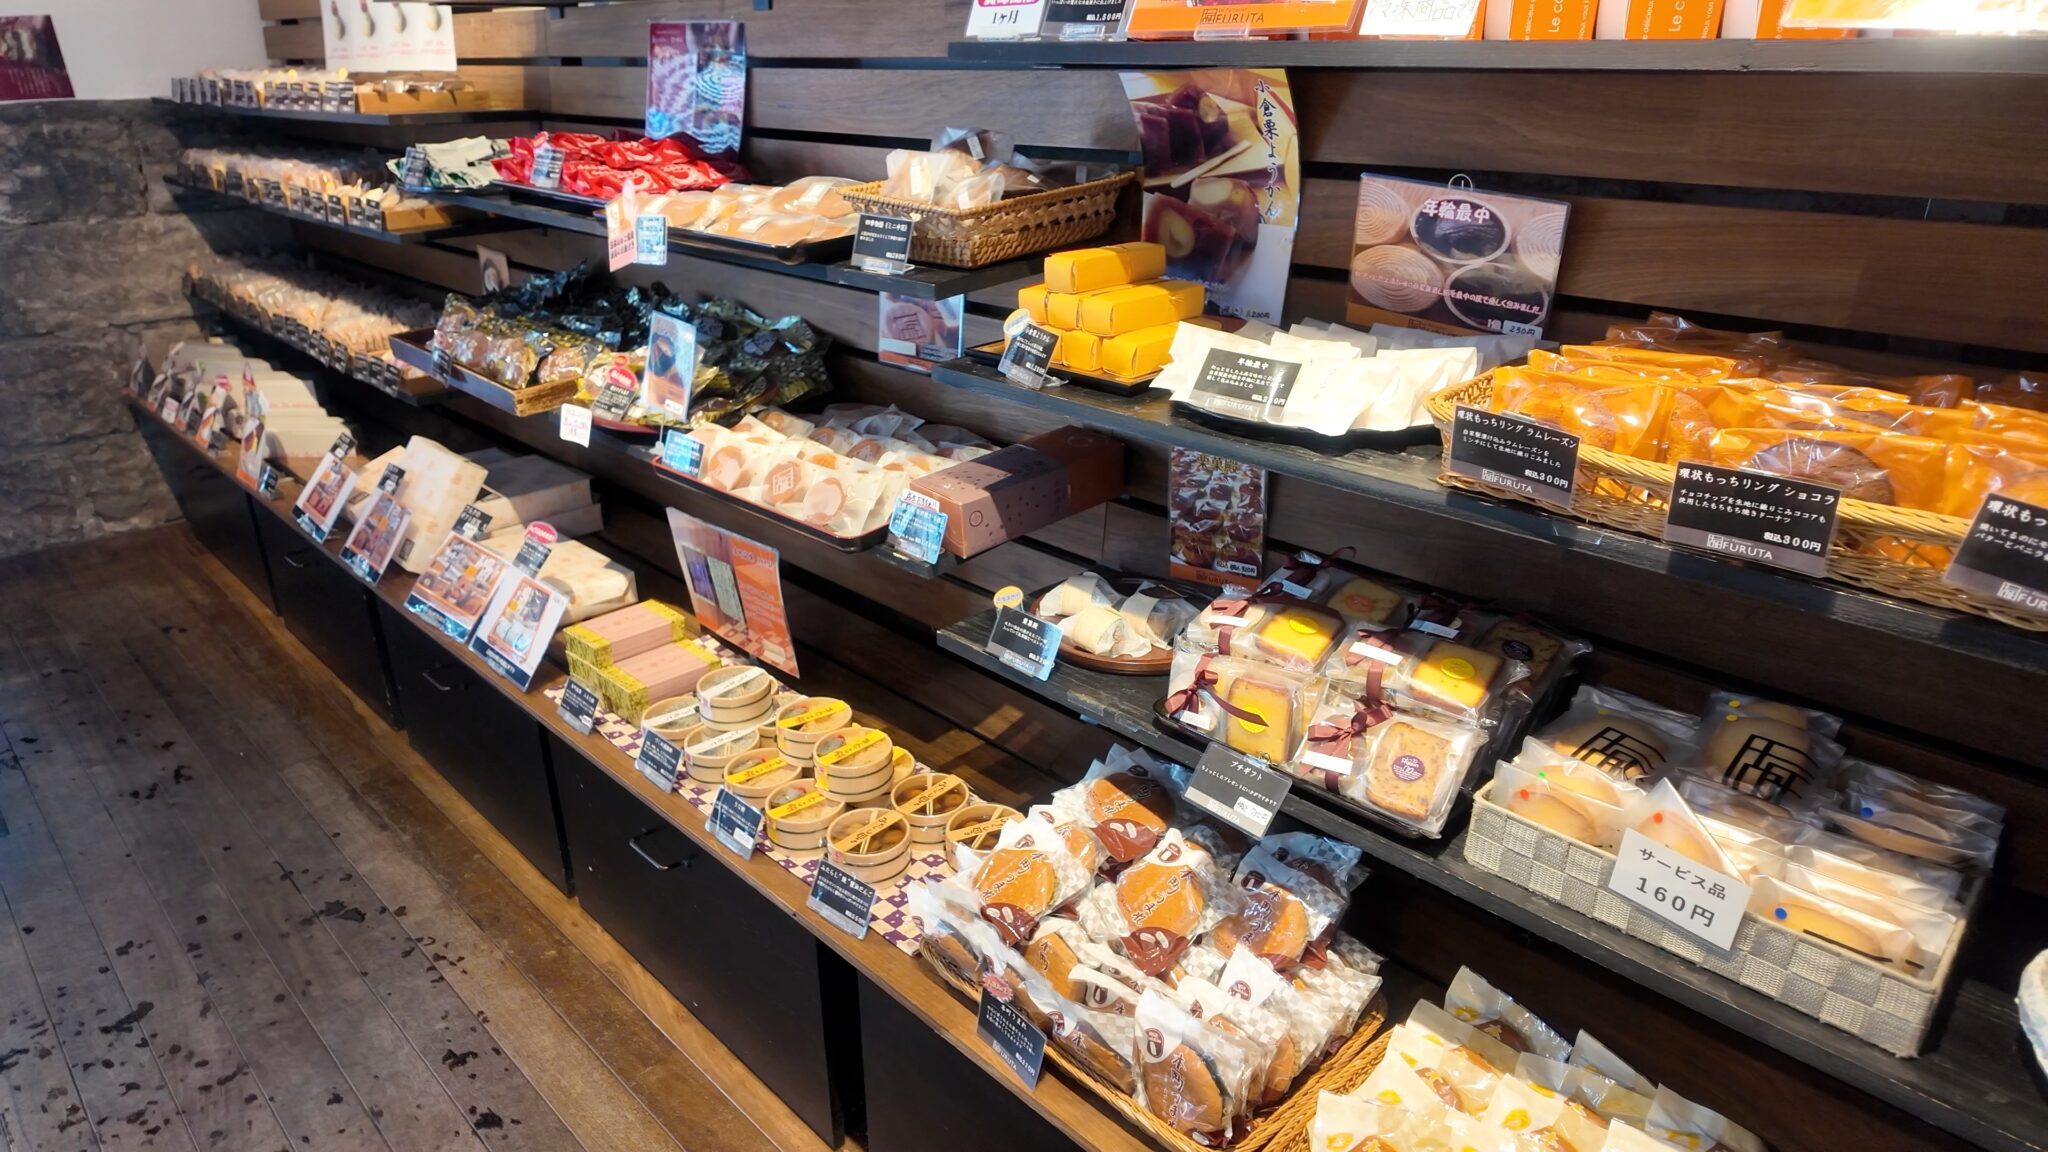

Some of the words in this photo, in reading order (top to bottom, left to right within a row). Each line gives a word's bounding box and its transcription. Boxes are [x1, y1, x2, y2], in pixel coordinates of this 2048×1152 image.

[1216, 13, 1264, 24] FURUTA
[1548, 17, 1561, 33] Le
[1668, 15, 1683, 32] Le
[1255, 79, 1281, 218] 小倉栗ようかん
[1422, 198, 1490, 224] 年輪最中
[1526, 427, 1577, 448] ラムレーズン
[1494, 475, 1533, 493] FURUTA
[1524, 469, 1569, 488] 税込300円
[1784, 485, 1836, 505] ショコラ
[1722, 541, 1773, 560] FURUTA
[1763, 532, 1822, 552] 税込300円
[1230, 760, 1263, 781] プチギフト
[1639, 848, 1727, 901] サービス品
[1636, 877, 1716, 928] 160円
